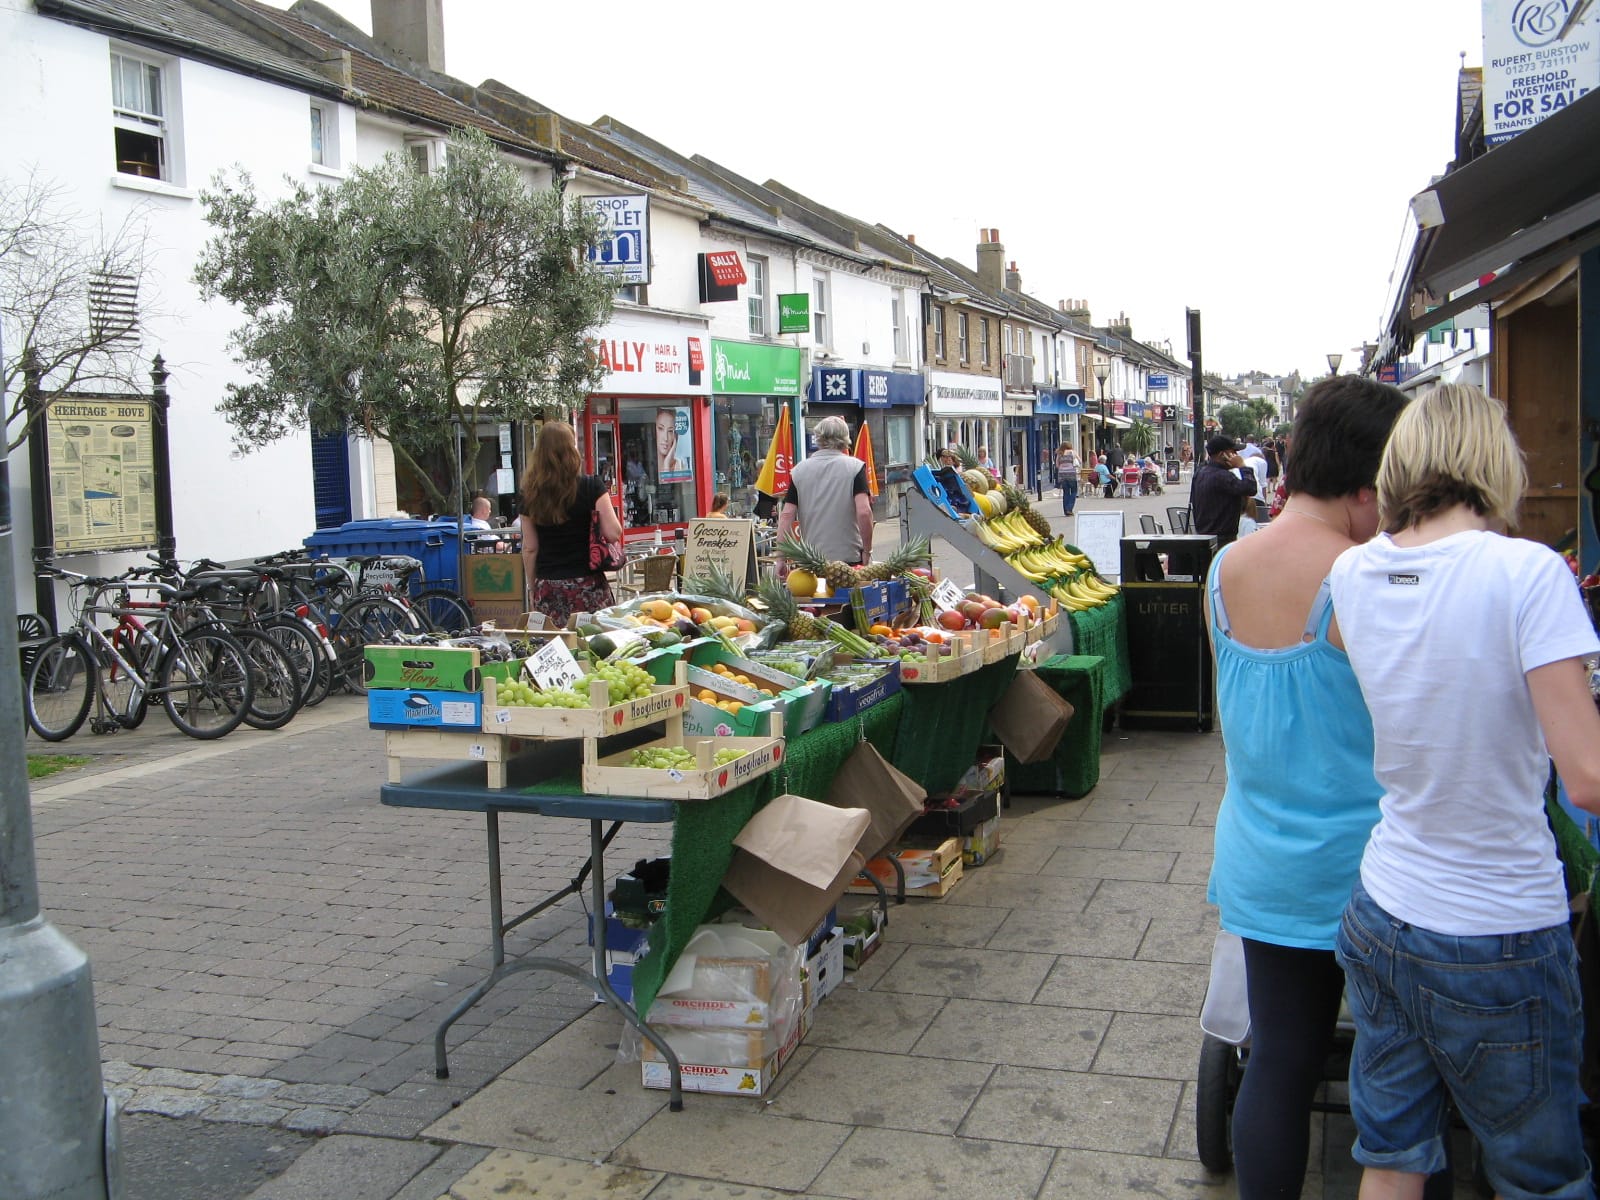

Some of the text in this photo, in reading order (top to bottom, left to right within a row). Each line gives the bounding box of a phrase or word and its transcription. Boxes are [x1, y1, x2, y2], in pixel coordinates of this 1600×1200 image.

[1491, 41, 1591, 68] RUPERT BURSTOW
[1505, 54, 1578, 76] 01273 731111
[1512, 69, 1569, 88] FREEHOLD
[1505, 78, 1577, 100] INVESTMENT
[1493, 98, 1535, 121] FOR
[1494, 117, 1533, 131] TENANTS
[596, 199, 629, 211] SHOP
[614, 210, 642, 226] LET
[710, 254, 738, 267] SALLY
[718, 272, 744, 280] BEAUTY
[654, 343, 678, 357] HAIR &
[655, 361, 682, 374] BEAUTY
[727, 360, 751, 381] mind
[875, 375, 888, 396] RBS
[54, 405, 108, 417] HERITAGE
[117, 407, 145, 418] HOVE
[693, 522, 729, 540] Gossip
[697, 537, 739, 549] Breakfast
[365, 572, 394, 581] Recycling
[1139, 603, 1189, 614] LITTER
[399, 667, 439, 688] Glory
[631, 697, 672, 719] Hoogstraten
[682, 718, 704, 734] eph
[734, 751, 770, 776] Hoogstraten
[672, 999, 737, 1009] ORCHIDEA
[679, 1065, 729, 1075] RCHIDEA
